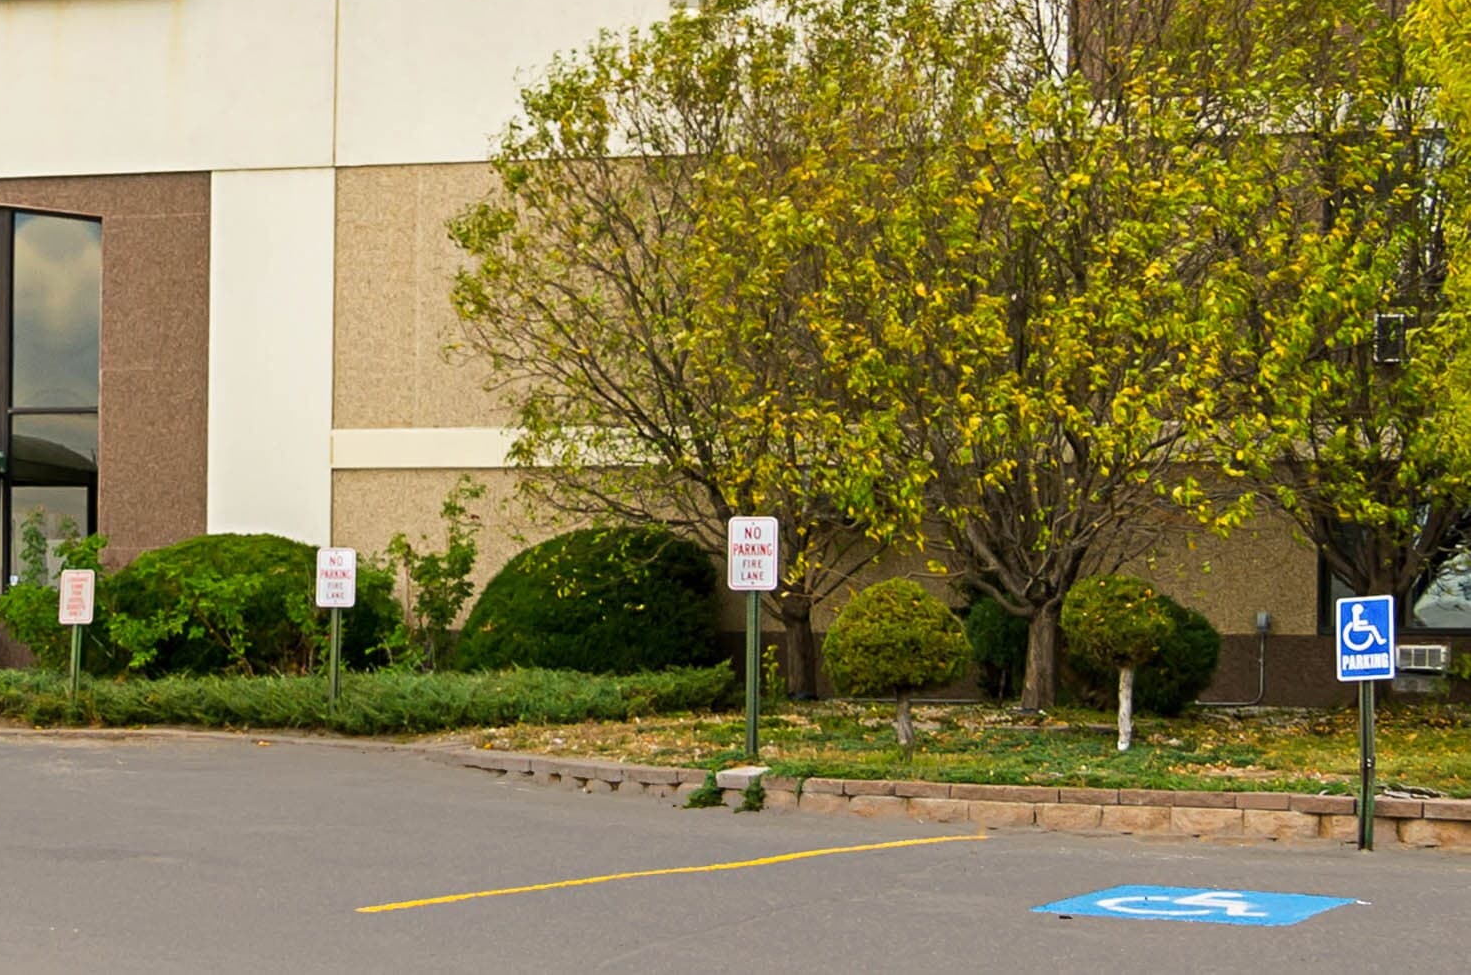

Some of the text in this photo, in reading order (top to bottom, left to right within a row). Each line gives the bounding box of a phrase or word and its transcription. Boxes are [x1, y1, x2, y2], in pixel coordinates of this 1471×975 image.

[744, 526, 762, 539] NO
[733, 543, 772, 556] PARKING
[329, 555, 344, 567] NO
[742, 559, 762, 568] FIRE
[741, 572, 764, 581] LANE
[1342, 652, 1390, 671] PARKING
